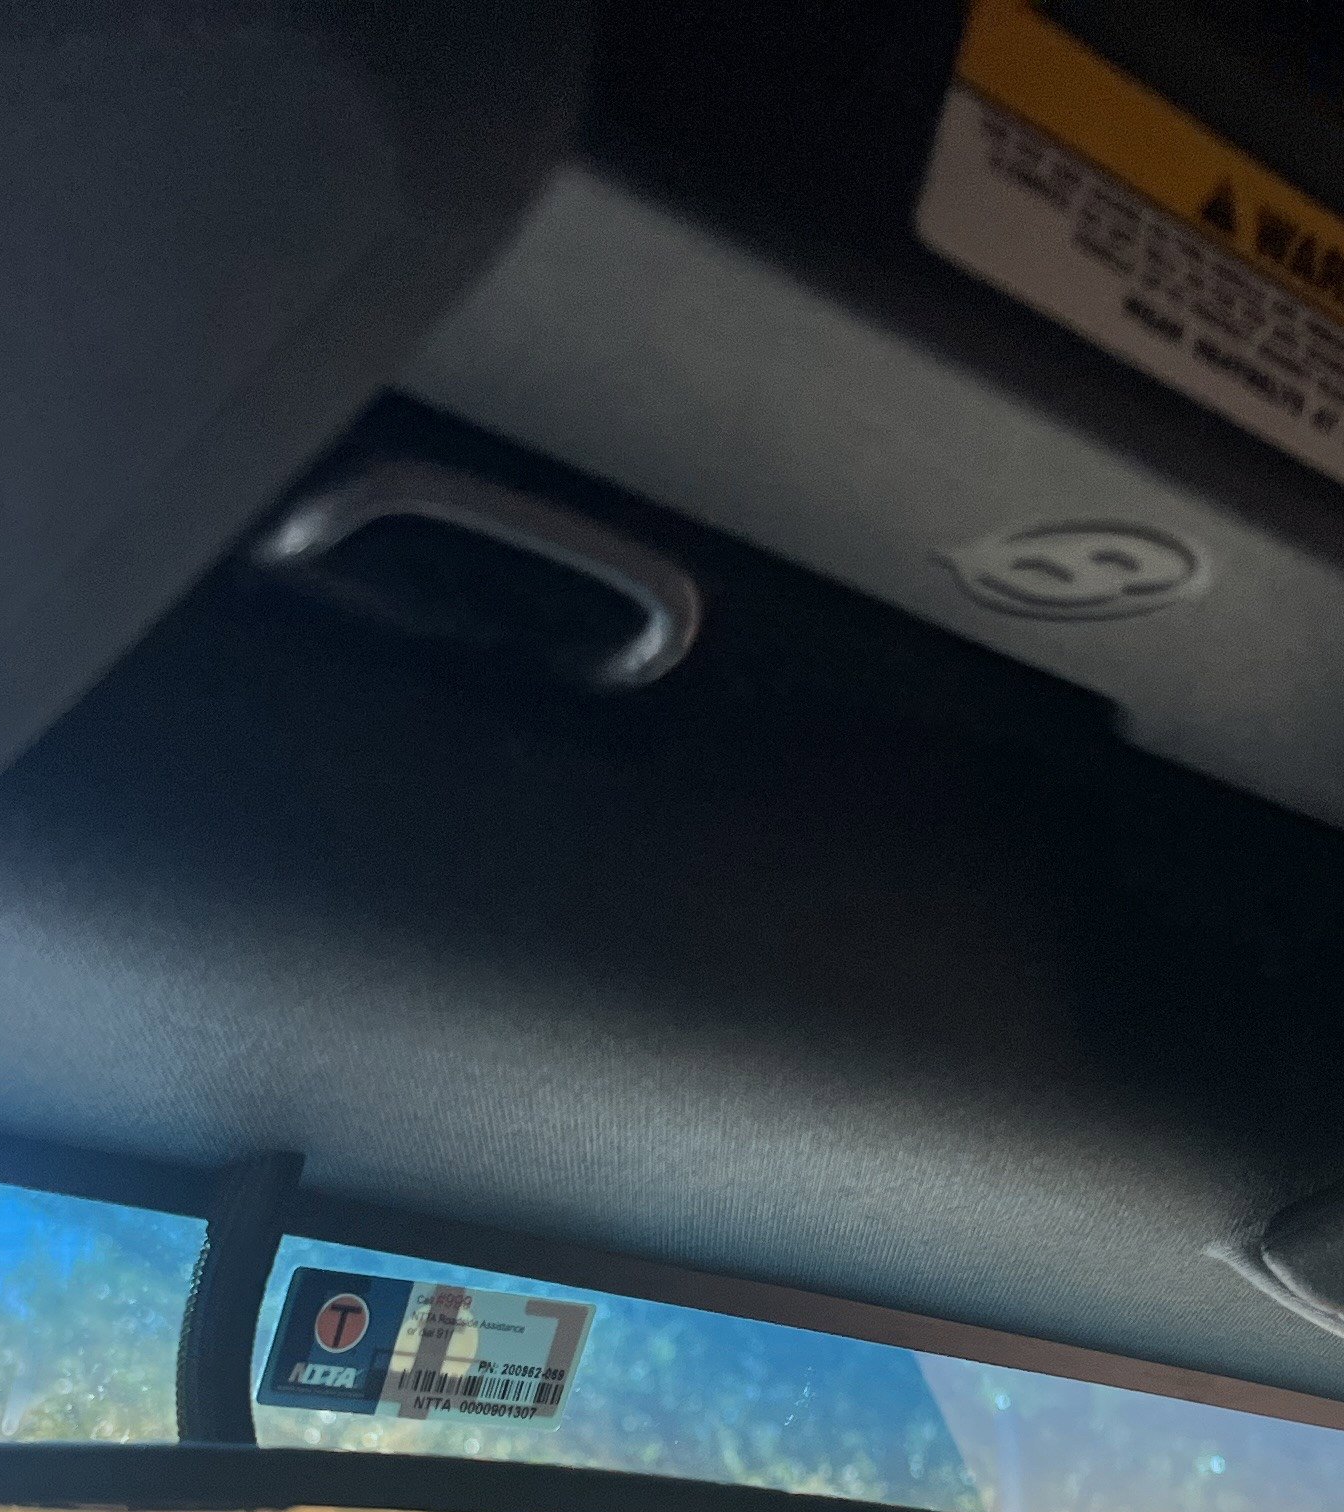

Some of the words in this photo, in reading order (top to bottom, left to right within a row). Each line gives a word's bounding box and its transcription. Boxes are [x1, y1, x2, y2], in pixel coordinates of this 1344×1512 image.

[479, 1319, 526, 1334] Assistance
[288, 1361, 357, 1390] NTTA
[413, 1395, 452, 1413] NTTA
